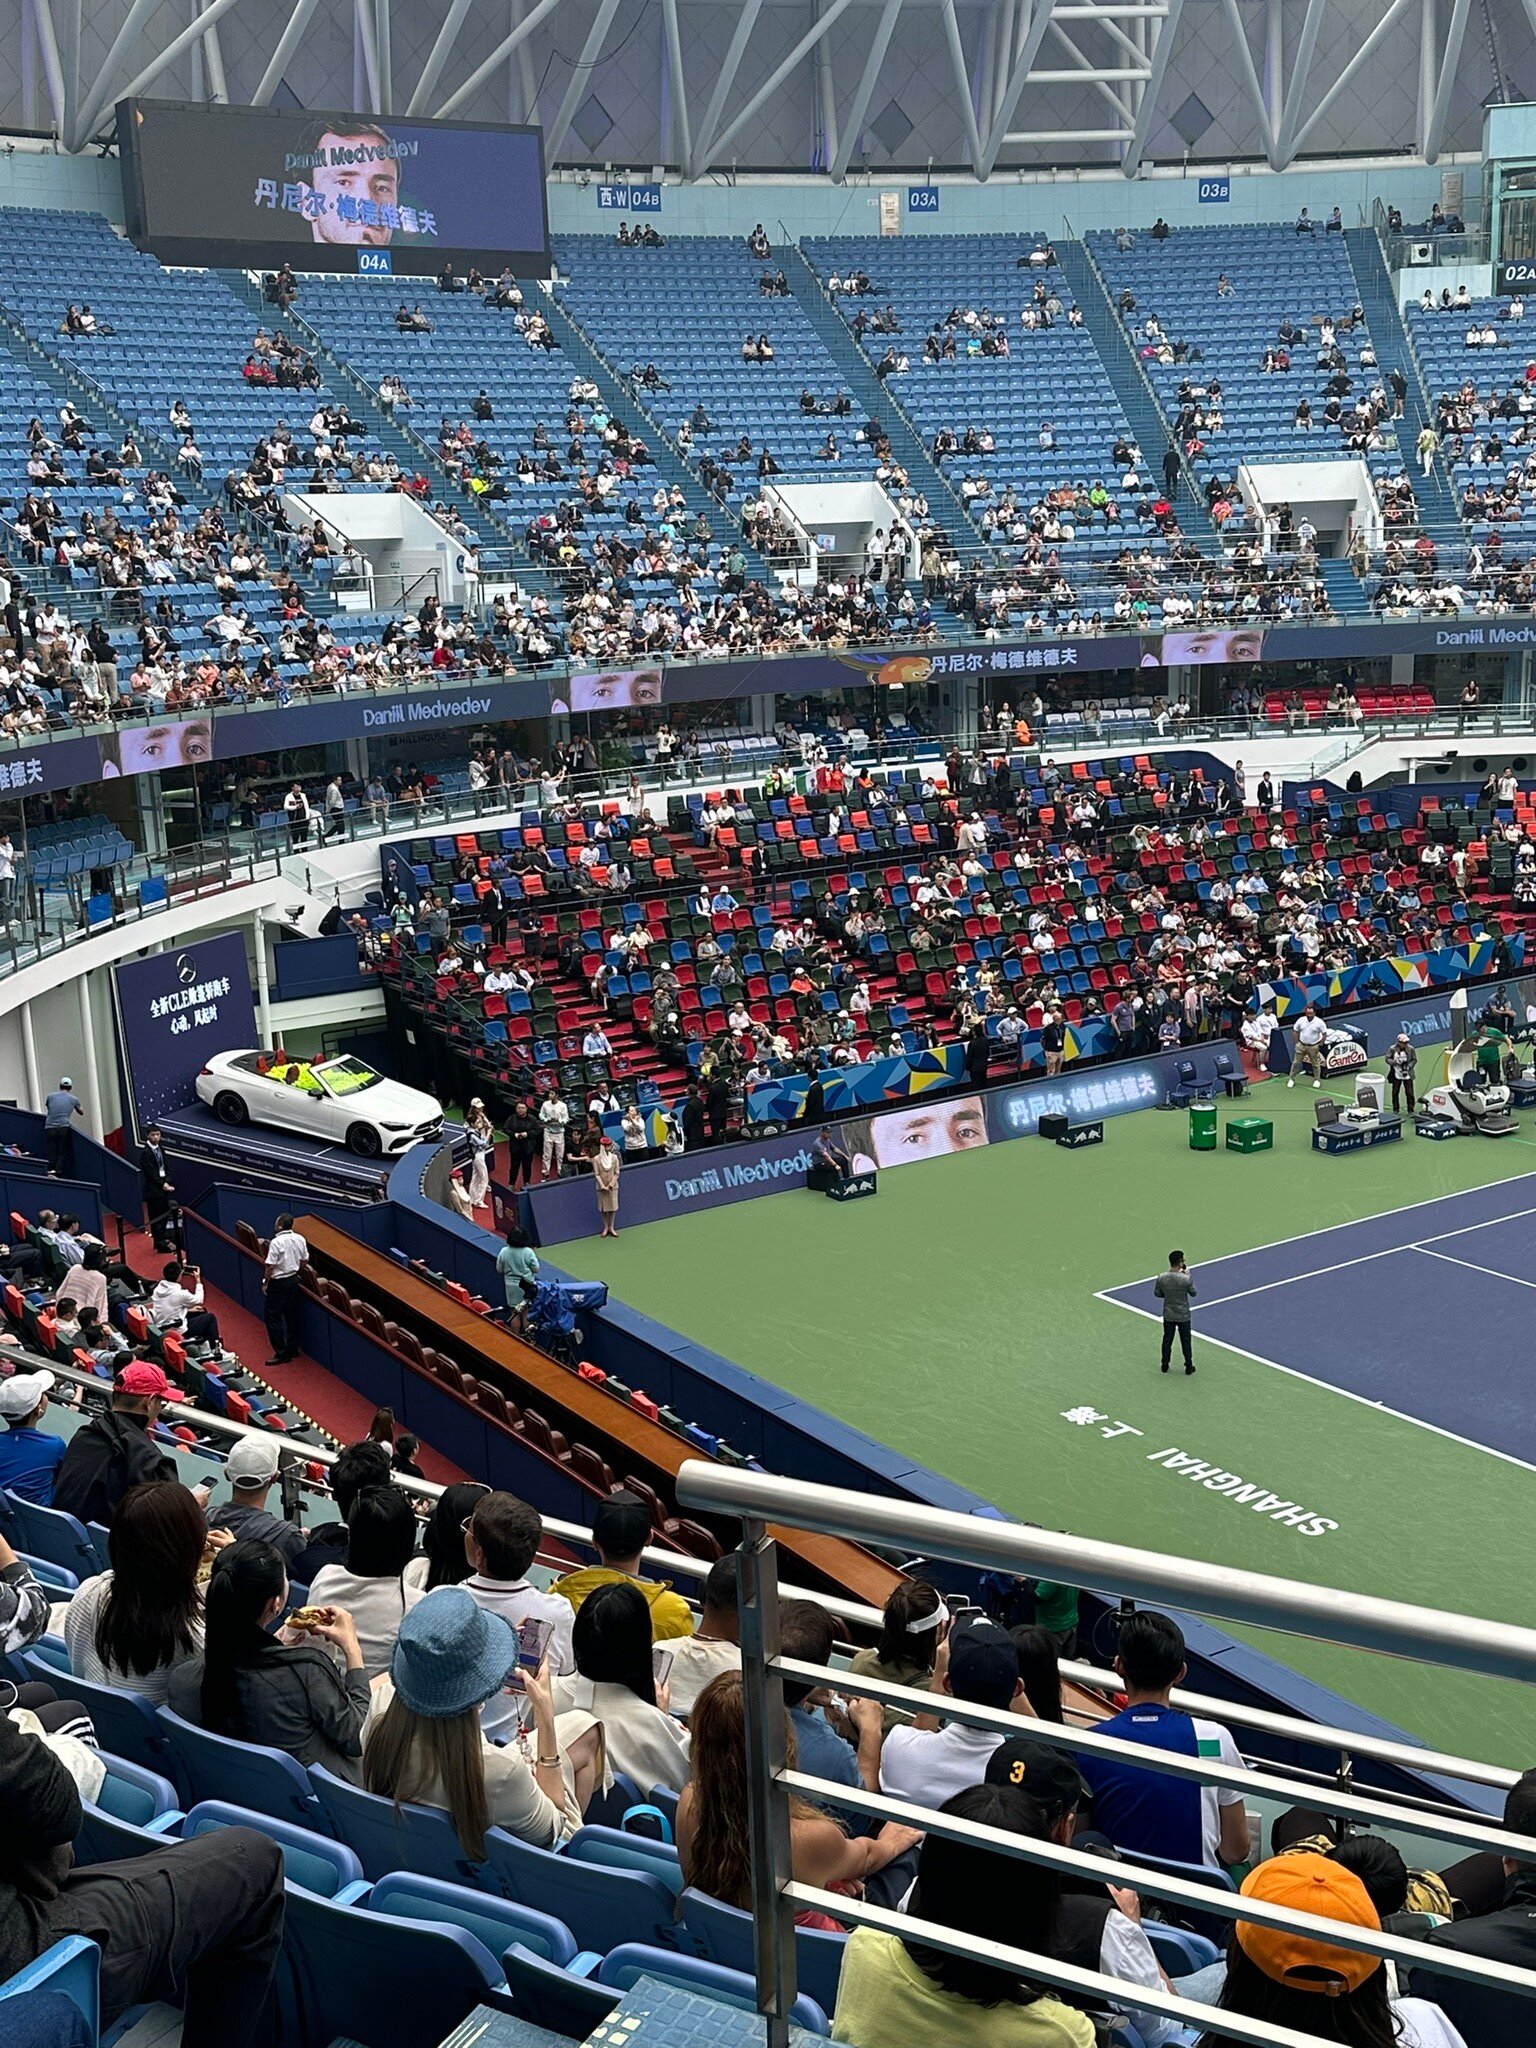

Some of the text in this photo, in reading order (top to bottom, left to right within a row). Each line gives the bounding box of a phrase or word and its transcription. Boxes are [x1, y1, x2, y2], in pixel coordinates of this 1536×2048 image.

[330, 140, 419, 167] Medvedev
[632, 191, 659, 206] 04B
[911, 192, 937, 207] 03A
[1201, 184, 1228, 197] 03B
[254, 178, 438, 236] 丹尼尔·梅德维德夫
[360, 254, 389, 270] 04A
[1505, 265, 1536, 281] 02A
[1436, 628, 1484, 646] Daniil
[931, 648, 1078, 674] 丹尼尔·梅德维德夫
[363, 696, 491, 727] Daniil Medvedev
[665, 1168, 723, 1201] Daniil
[1146, 1447, 1339, 1536] SHANGHAI
[1009, 1760, 1026, 1784] 3
